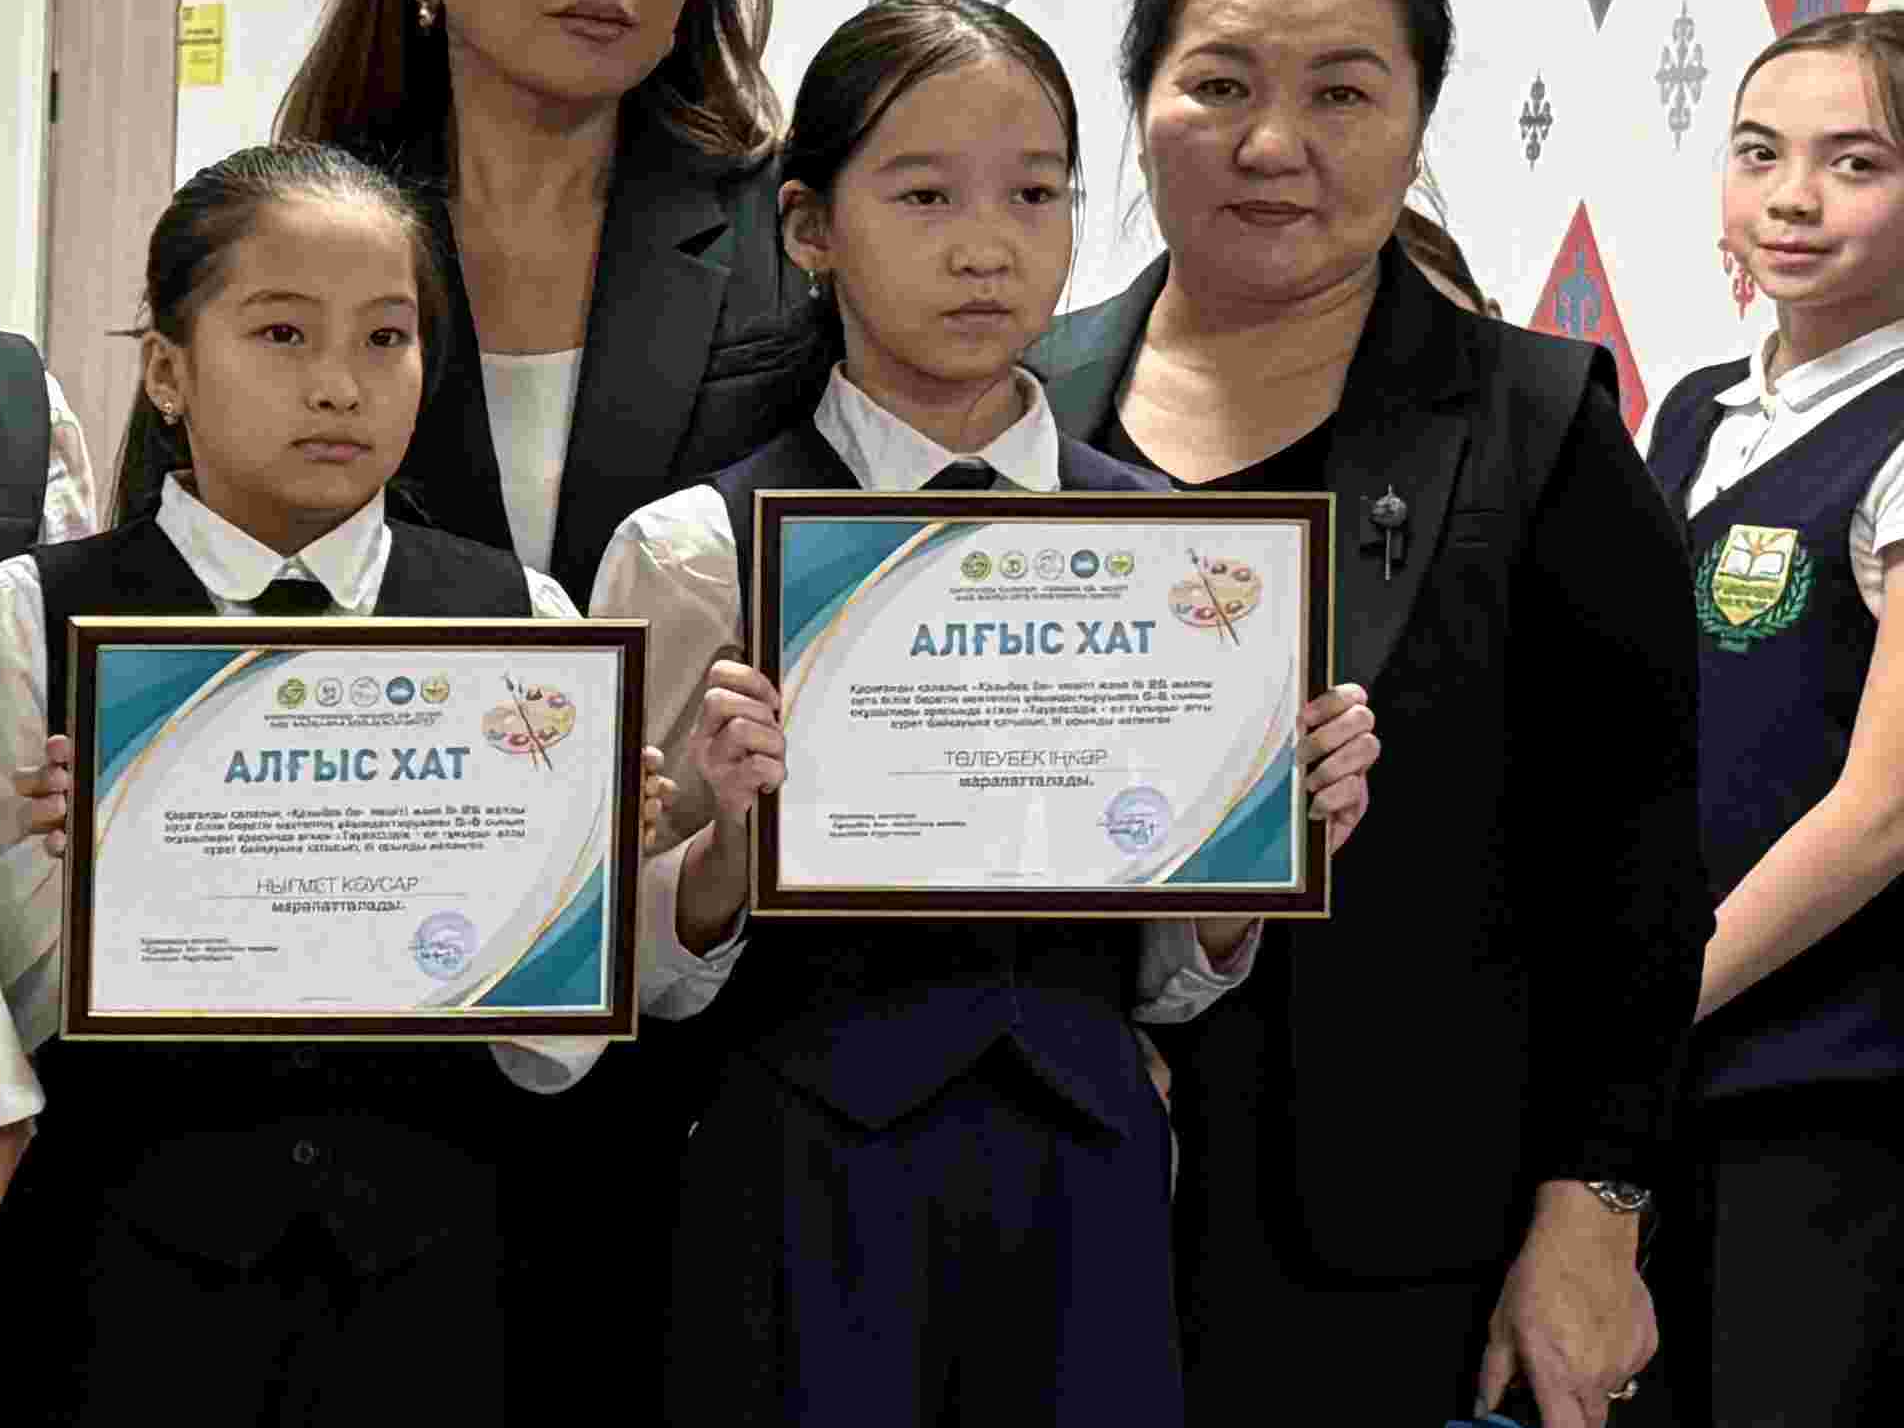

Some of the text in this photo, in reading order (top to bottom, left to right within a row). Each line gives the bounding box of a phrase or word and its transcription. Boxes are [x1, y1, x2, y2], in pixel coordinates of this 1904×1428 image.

[910, 621, 1156, 657] АЛҒЫС ХАТ
[224, 747, 470, 784] АЛҒЫС ХАТ
